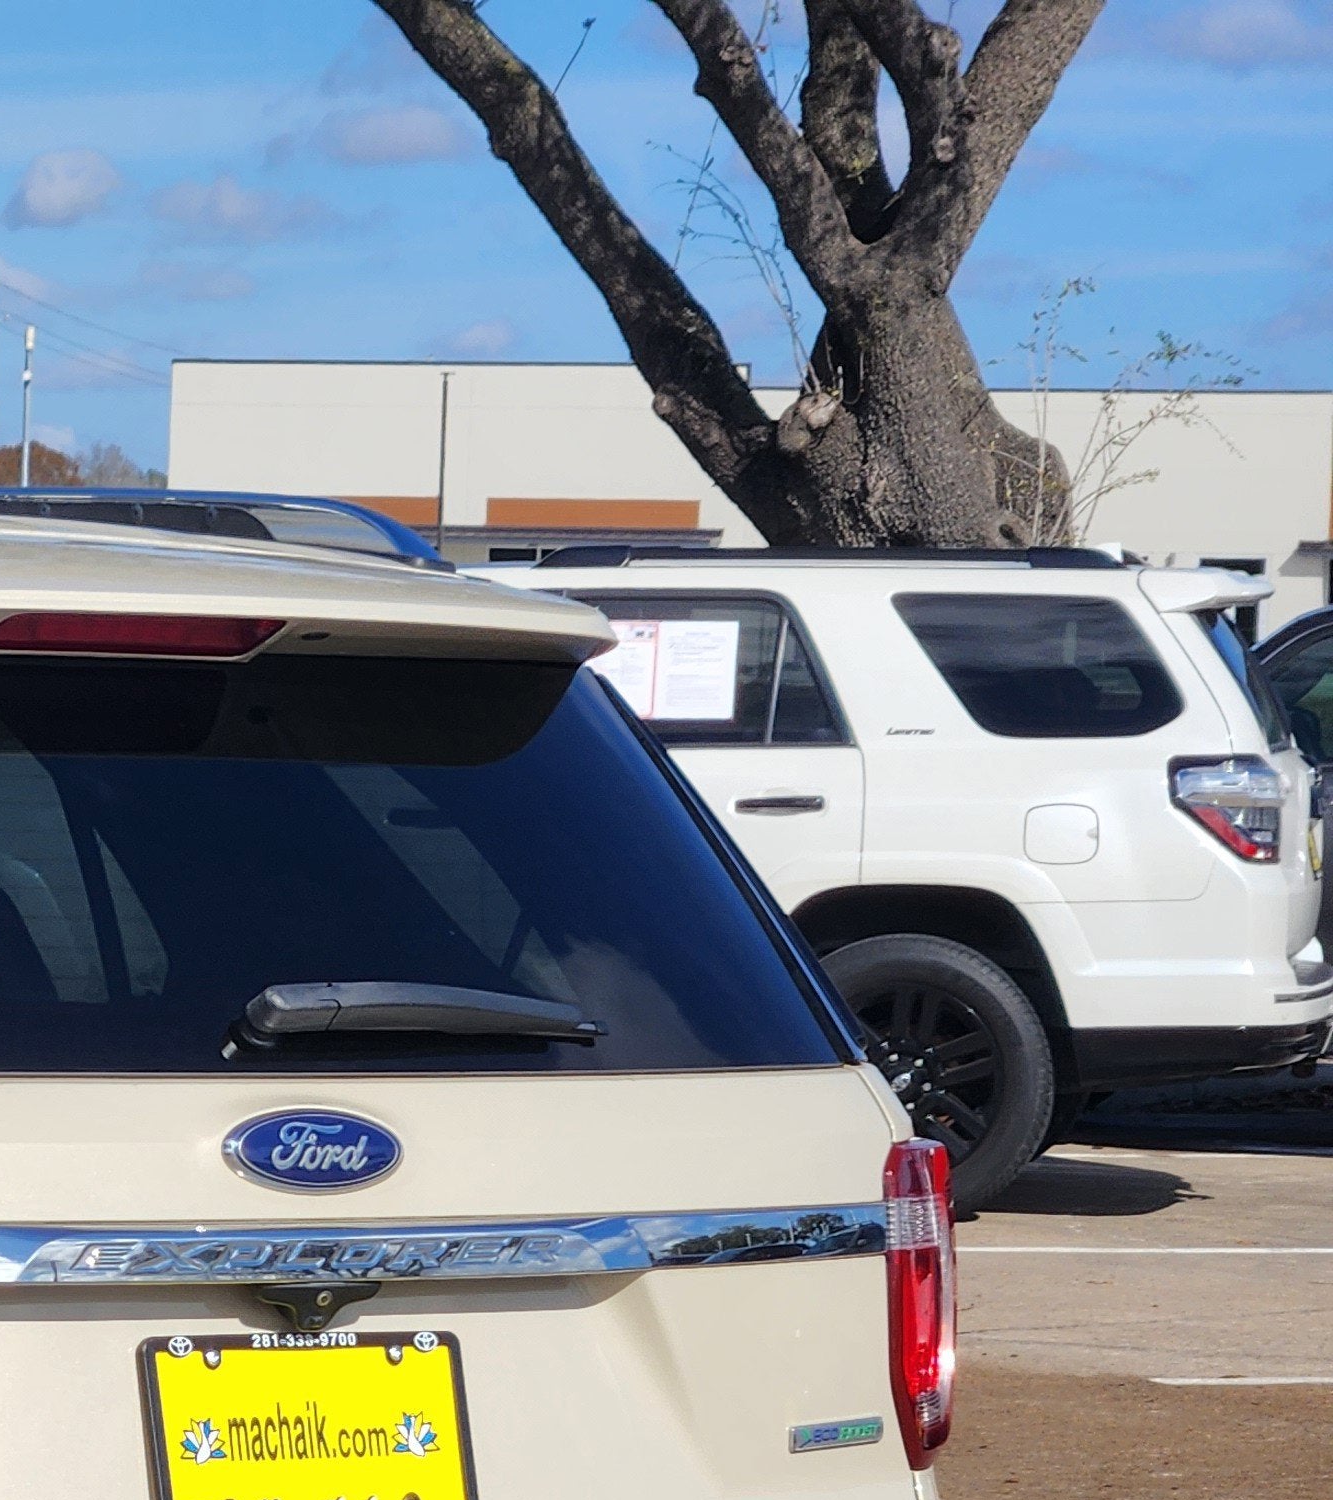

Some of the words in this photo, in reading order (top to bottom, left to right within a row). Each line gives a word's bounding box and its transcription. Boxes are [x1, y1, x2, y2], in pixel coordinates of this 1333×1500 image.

[271, 1121, 368, 1171] Ford
[70, 1236, 564, 1272] EXPLORER
[227, 1401, 390, 1461] machaik.com
